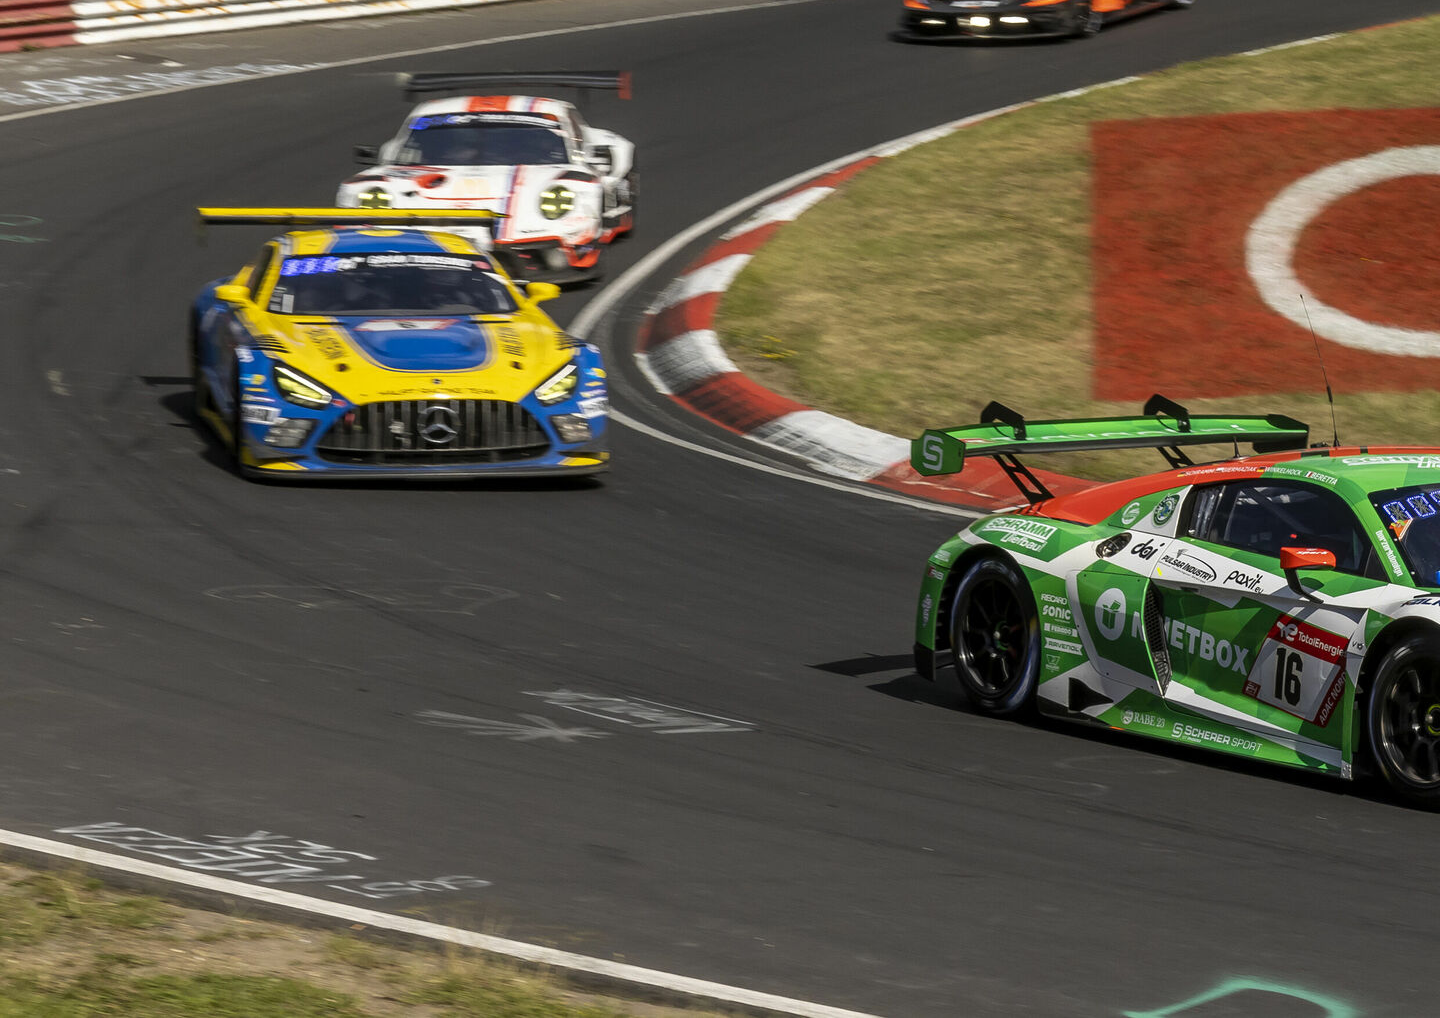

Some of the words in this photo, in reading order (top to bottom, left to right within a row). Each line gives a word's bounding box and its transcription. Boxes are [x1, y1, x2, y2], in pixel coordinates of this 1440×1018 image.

[1264, 465, 1303, 476] WINKELHOCK
[1311, 470, 1339, 486] BERETTA
[983, 518, 1057, 540] SCHRAMM
[1161, 554, 1186, 570] PULSAR
[1182, 561, 1214, 582] INDUSTRY
[1041, 593, 1068, 605] RECARO
[1042, 604, 1072, 620] SONIC
[1298, 630, 1345, 658] TotalEnergie
[1274, 646, 1304, 707] 16
[1134, 711, 1154, 726] RABE
[1320, 697, 1333, 725] ADAC
[1184, 725, 1231, 745] SCHERER
[1231, 737, 1263, 752] SPORT
